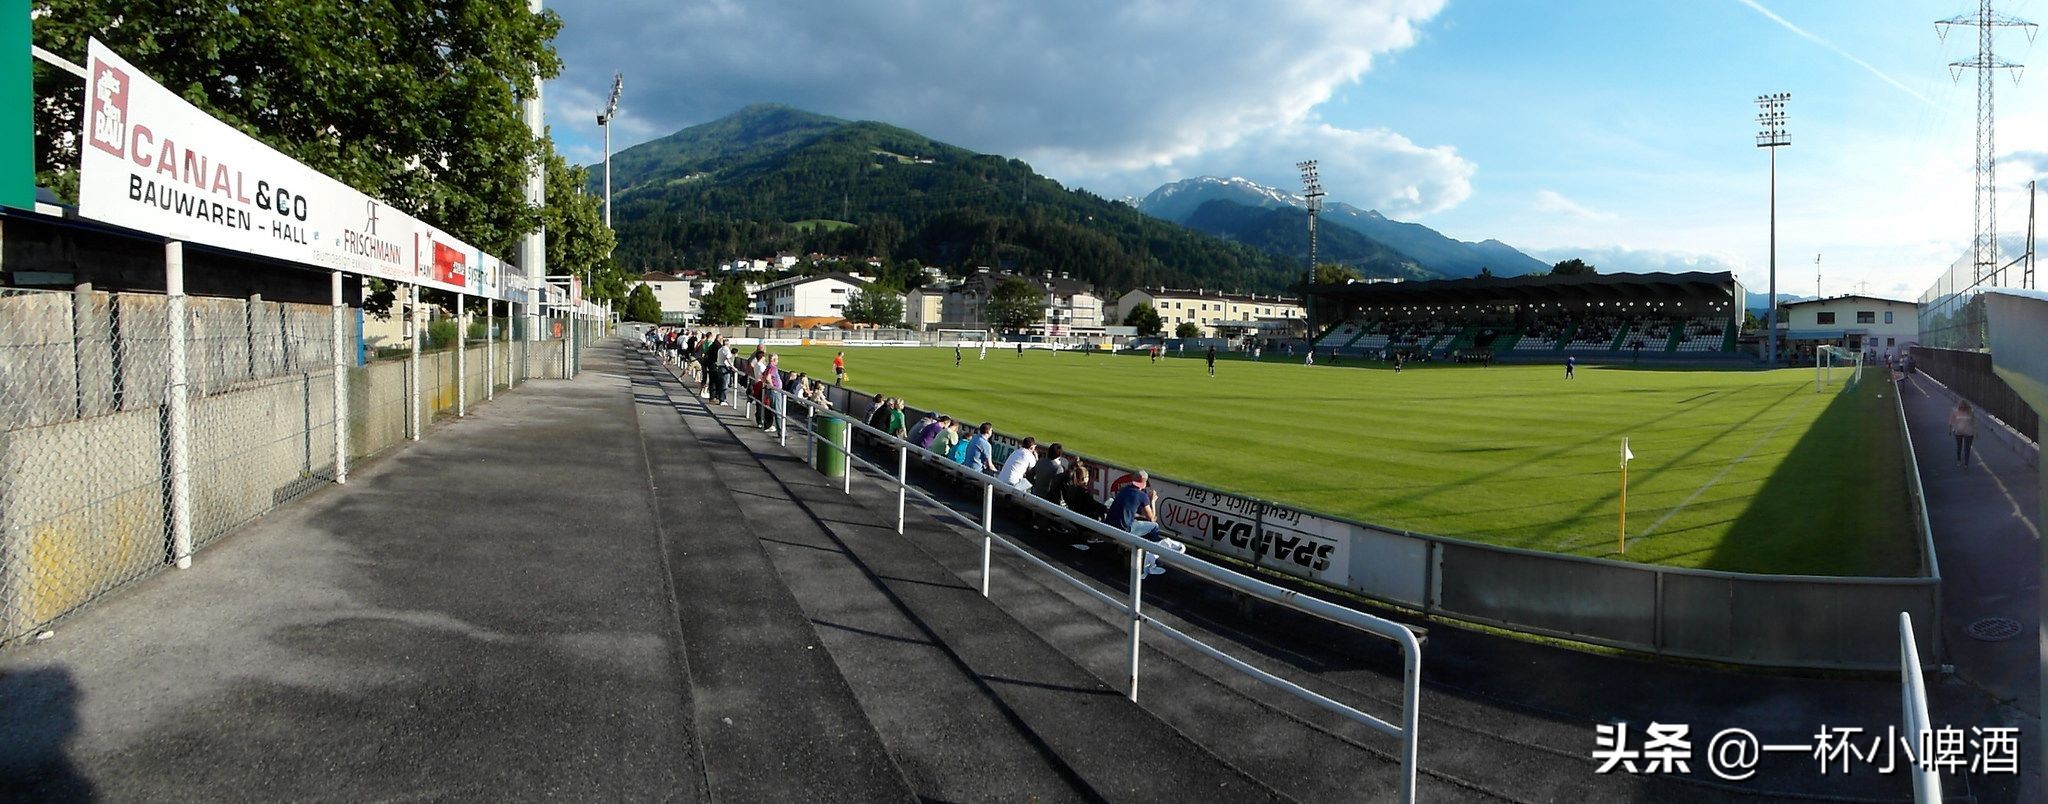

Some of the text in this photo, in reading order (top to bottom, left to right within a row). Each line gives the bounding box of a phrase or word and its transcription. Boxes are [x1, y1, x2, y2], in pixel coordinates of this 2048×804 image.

[95, 110, 124, 150] BAU
[129, 173, 251, 231] BAUWAREN
[272, 220, 308, 246] HALL
[344, 228, 401, 265] FRISCHMANN
[1186, 488, 1209, 503] fair
